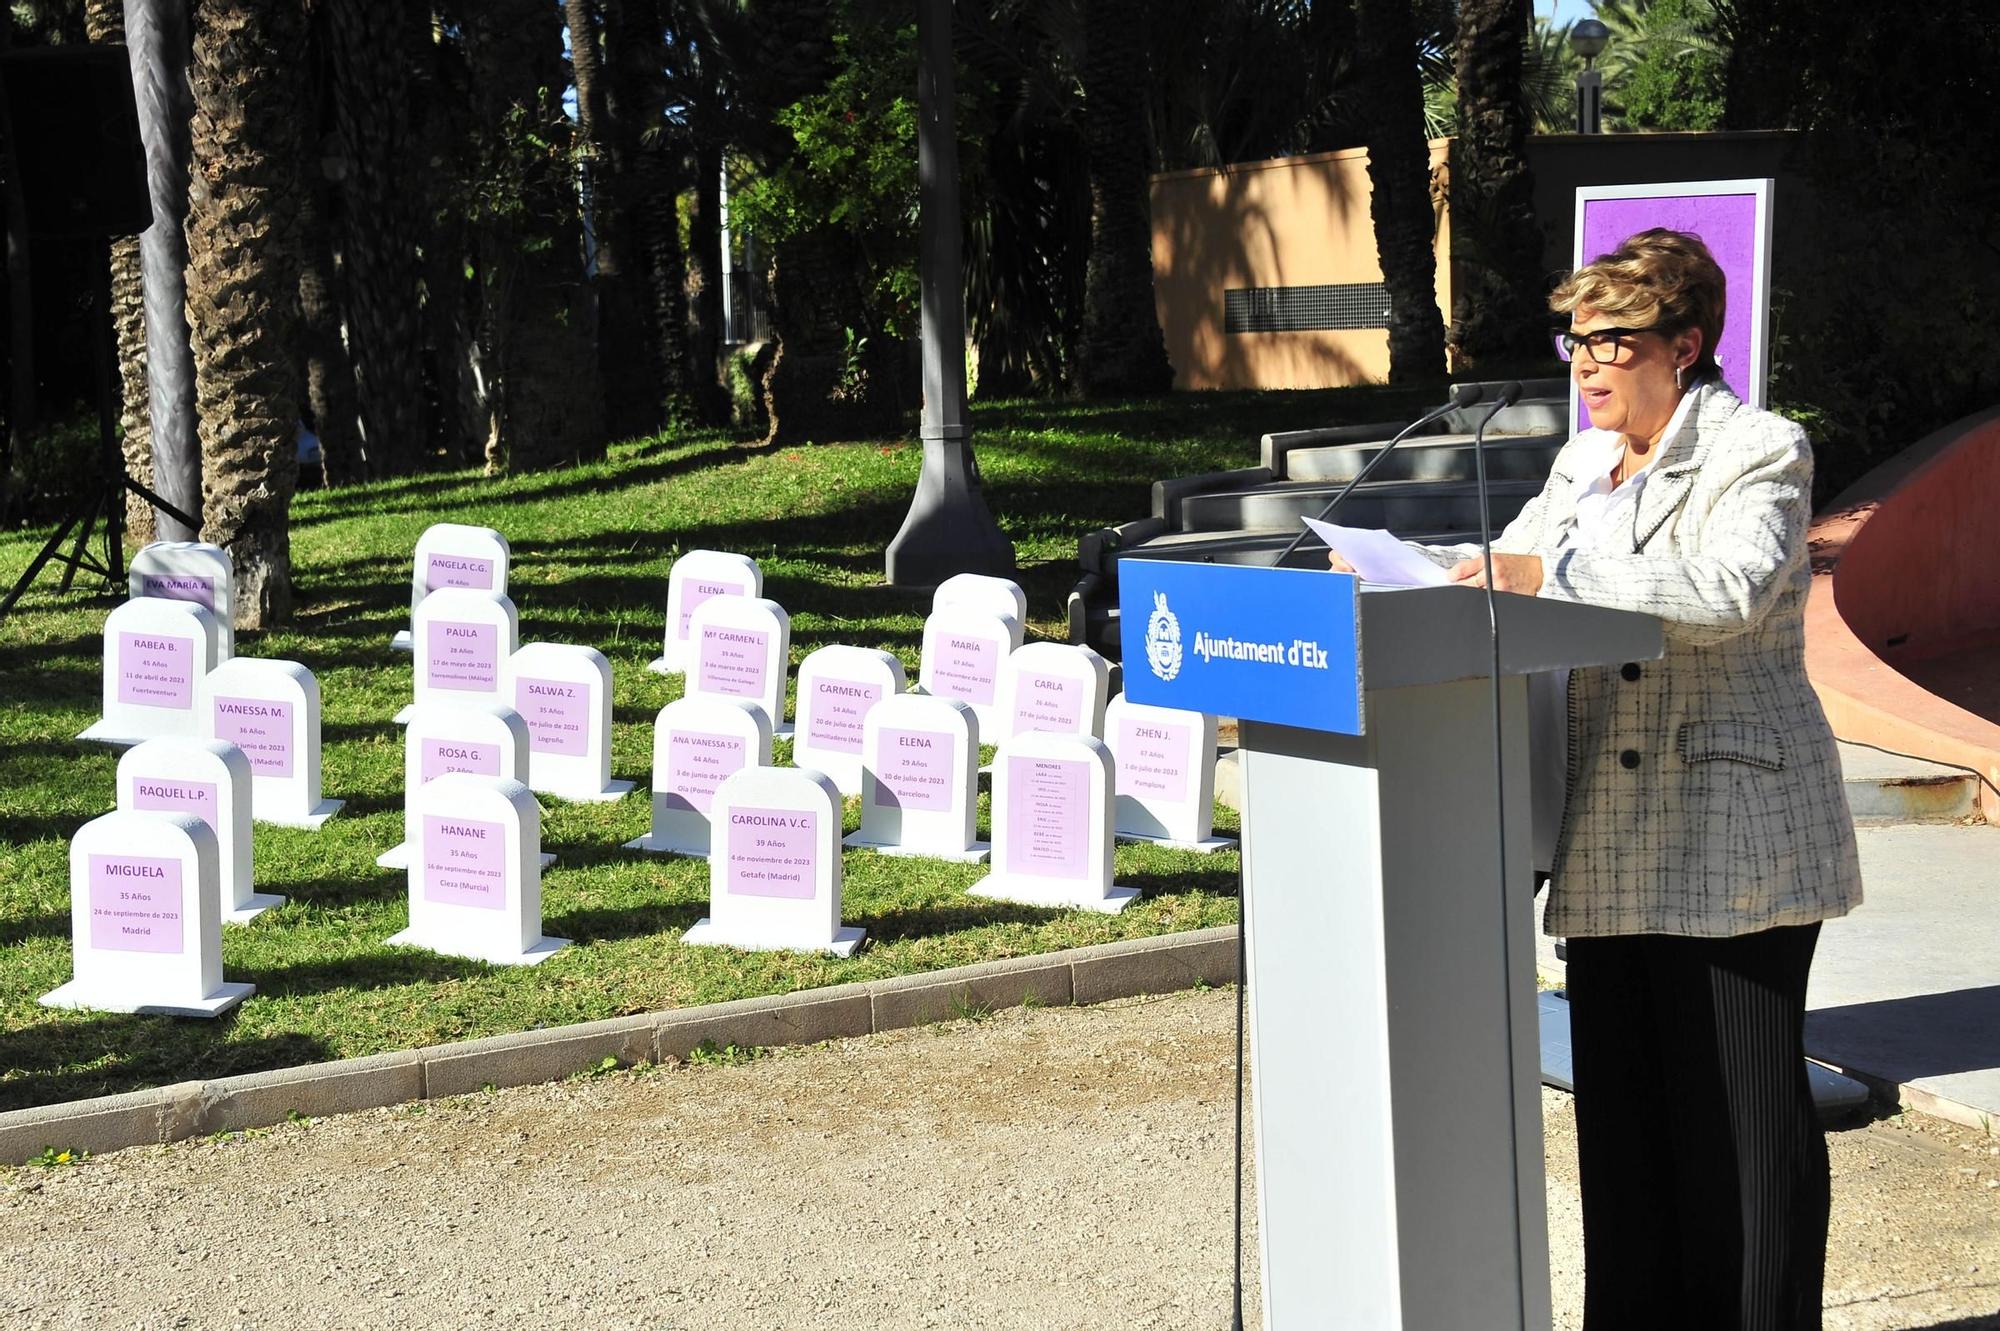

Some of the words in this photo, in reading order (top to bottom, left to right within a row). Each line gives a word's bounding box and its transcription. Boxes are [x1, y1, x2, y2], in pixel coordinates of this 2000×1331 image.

[432, 559, 467, 570] ANGELA
[698, 585, 725, 595] ELENA
[446, 628, 478, 638] PAULA
[718, 632, 755, 644] CARMEN
[134, 639, 165, 650] RABEA
[168, 642, 177, 651] B.
[951, 639, 980, 651] MARÍA
[1193, 631, 1285, 664] Ajuntament
[1288, 639, 1329, 670] d'Elx
[152, 660, 168, 668] Años
[450, 661, 467, 669] mayo
[745, 666, 759, 674] 2023
[135, 672, 142, 680] de
[169, 676, 184, 684] 2023
[1034, 679, 1063, 691] CARLA
[132, 687, 177, 697] Fuerteventura
[529, 685, 564, 697] SALWA
[567, 688, 575, 698] Z.
[819, 683, 861, 698] CARMEN
[864, 690, 873, 699] C.
[219, 703, 268, 716] VANESSA
[271, 708, 285, 718] M.
[549, 707, 564, 716] Años
[538, 721, 552, 730] julio
[833, 720, 847, 729] julio
[249, 727, 266, 735] Años
[1136, 727, 1161, 739] ZHEN
[1164, 731, 1171, 740] J.
[269, 744, 285, 752] 2023
[673, 736, 689, 745] ANA
[691, 738, 726, 749] VANESSA
[727, 741, 741, 750] S.P.
[899, 736, 932, 749] ELENA
[438, 747, 467, 760] ROSA
[470, 750, 482, 761] G.
[254, 758, 284, 767] (Madrid)
[703, 756, 719, 765] Años
[911, 760, 928, 768] Años
[691, 771, 708, 780] junio
[903, 774, 917, 783] julio
[928, 776, 945, 785] 2023
[140, 785, 185, 799] RAQUEL
[188, 789, 208, 801] L.P.
[897, 789, 930, 799] Barcelona
[731, 814, 786, 827] CAROLINA
[789, 818, 810, 829] V.C.
[441, 824, 486, 839] HANANE
[756, 839, 765, 847] 39
[767, 840, 786, 849] Años
[460, 850, 478, 859] Años
[746, 856, 782, 864] noviembre
[106, 864, 164, 878] MIGUELA
[444, 865, 477, 875] septiembre
[487, 870, 501, 878] 2023
[740, 870, 766, 880] Getafe
[767, 871, 801, 882] (Madrid)
[460, 881, 489, 893] (Murcia)
[120, 892, 129, 900] 35
[131, 892, 151, 901] Años
[104, 908, 112, 916] de
[113, 910, 150, 919] septiembre
[122, 926, 151, 935] Madrid
